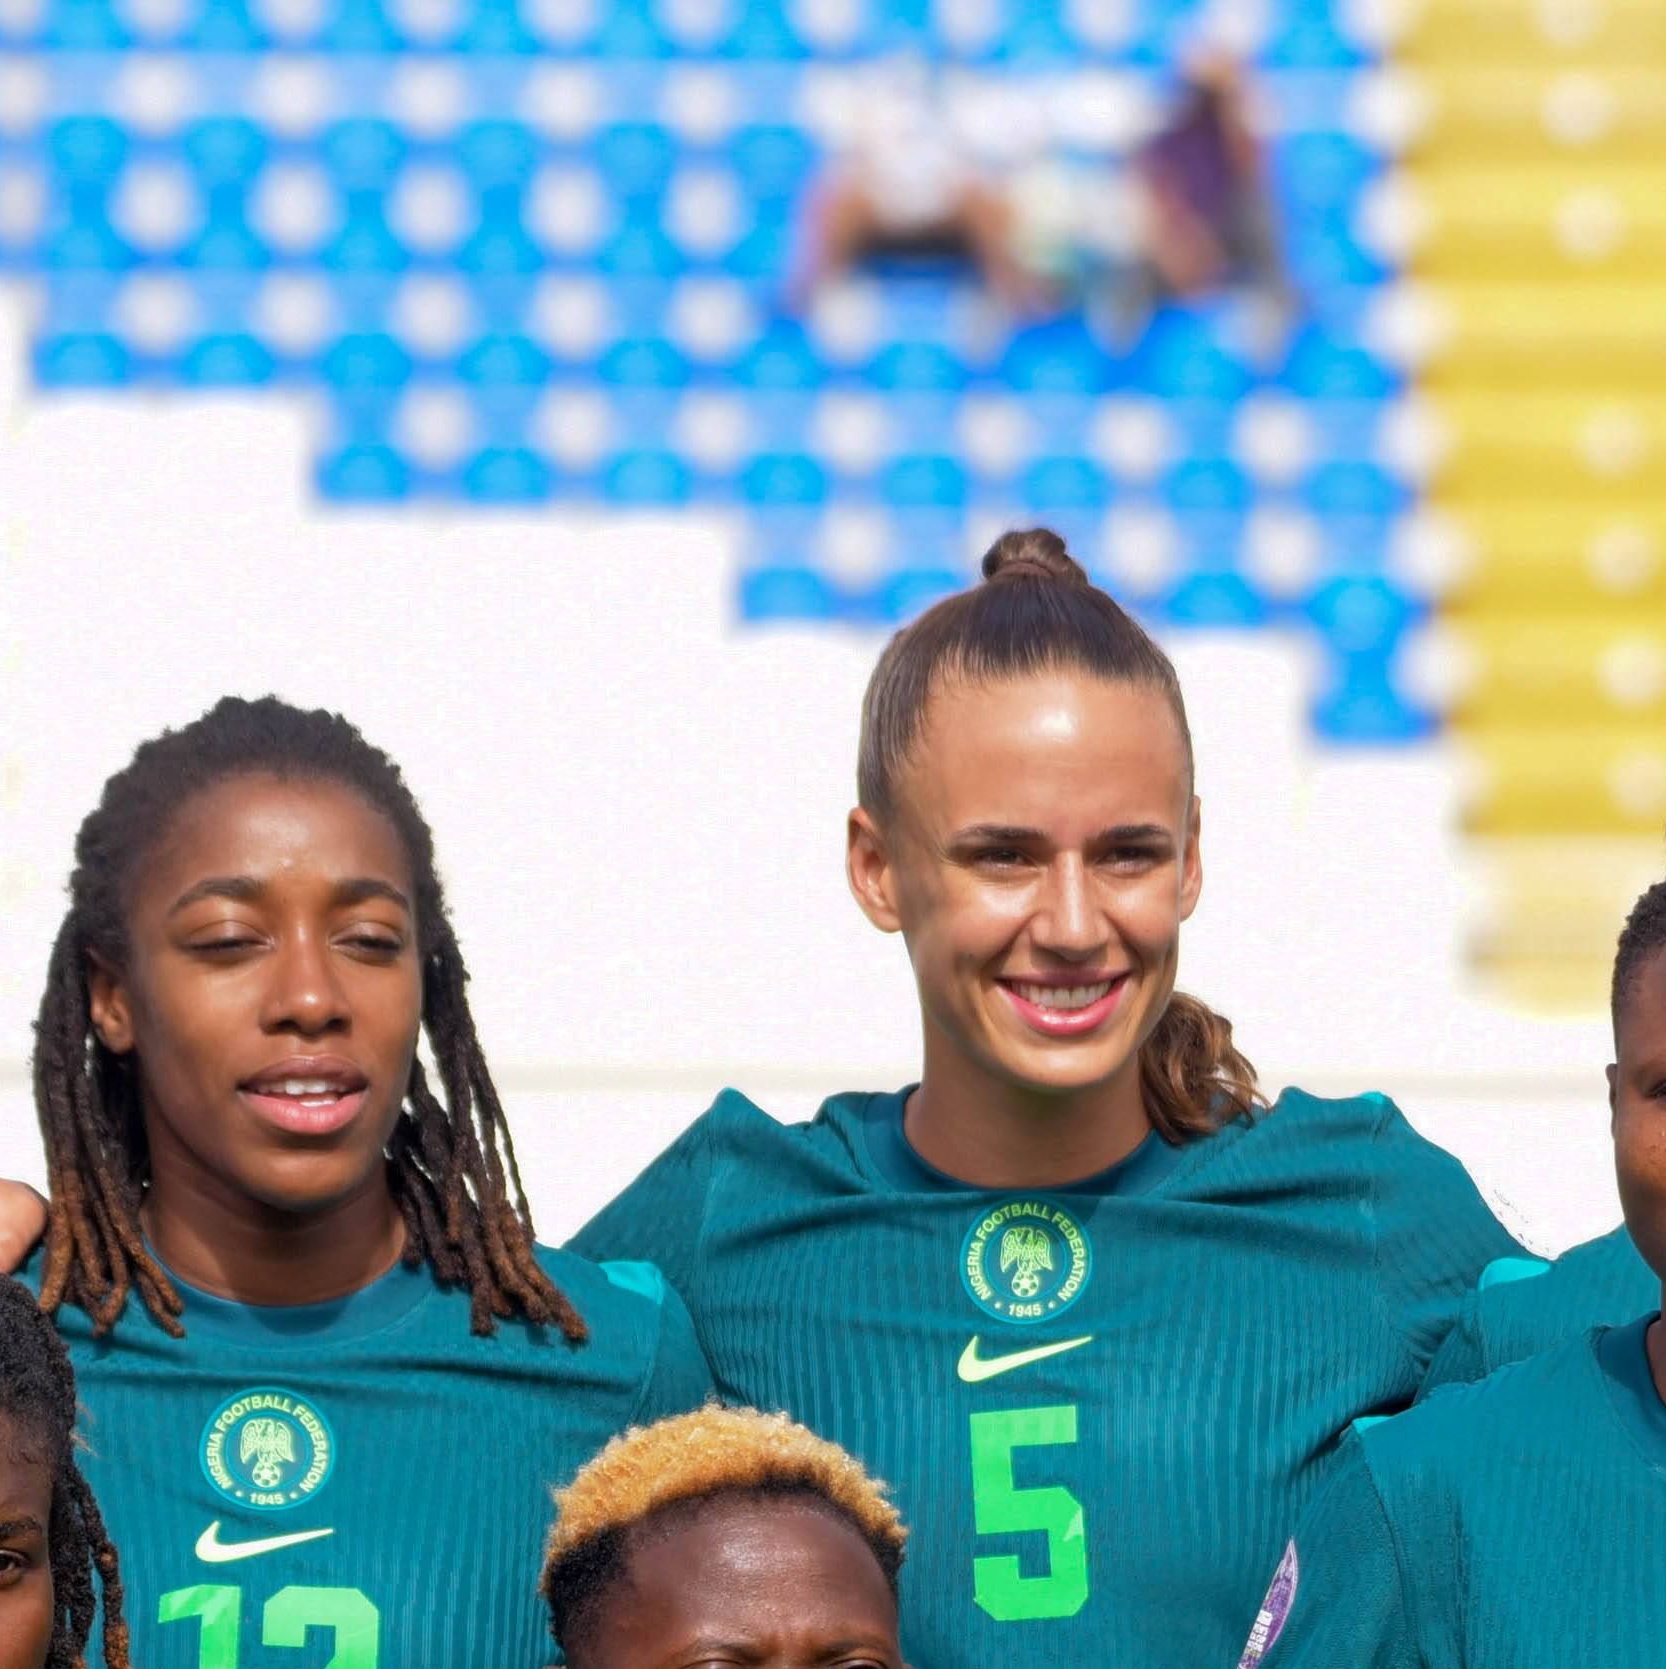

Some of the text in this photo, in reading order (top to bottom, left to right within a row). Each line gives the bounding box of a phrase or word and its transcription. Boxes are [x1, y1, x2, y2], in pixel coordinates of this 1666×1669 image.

[967, 1203, 1085, 1301] NIGERIA FOOTBALL FEDERATION
[1009, 1303, 1042, 1317] 1945
[207, 1395, 327, 1493] NIGERIA FOOTBALL FEDERATION
[250, 1493, 284, 1505] 1945
[969, 1405, 1088, 1622] 5
